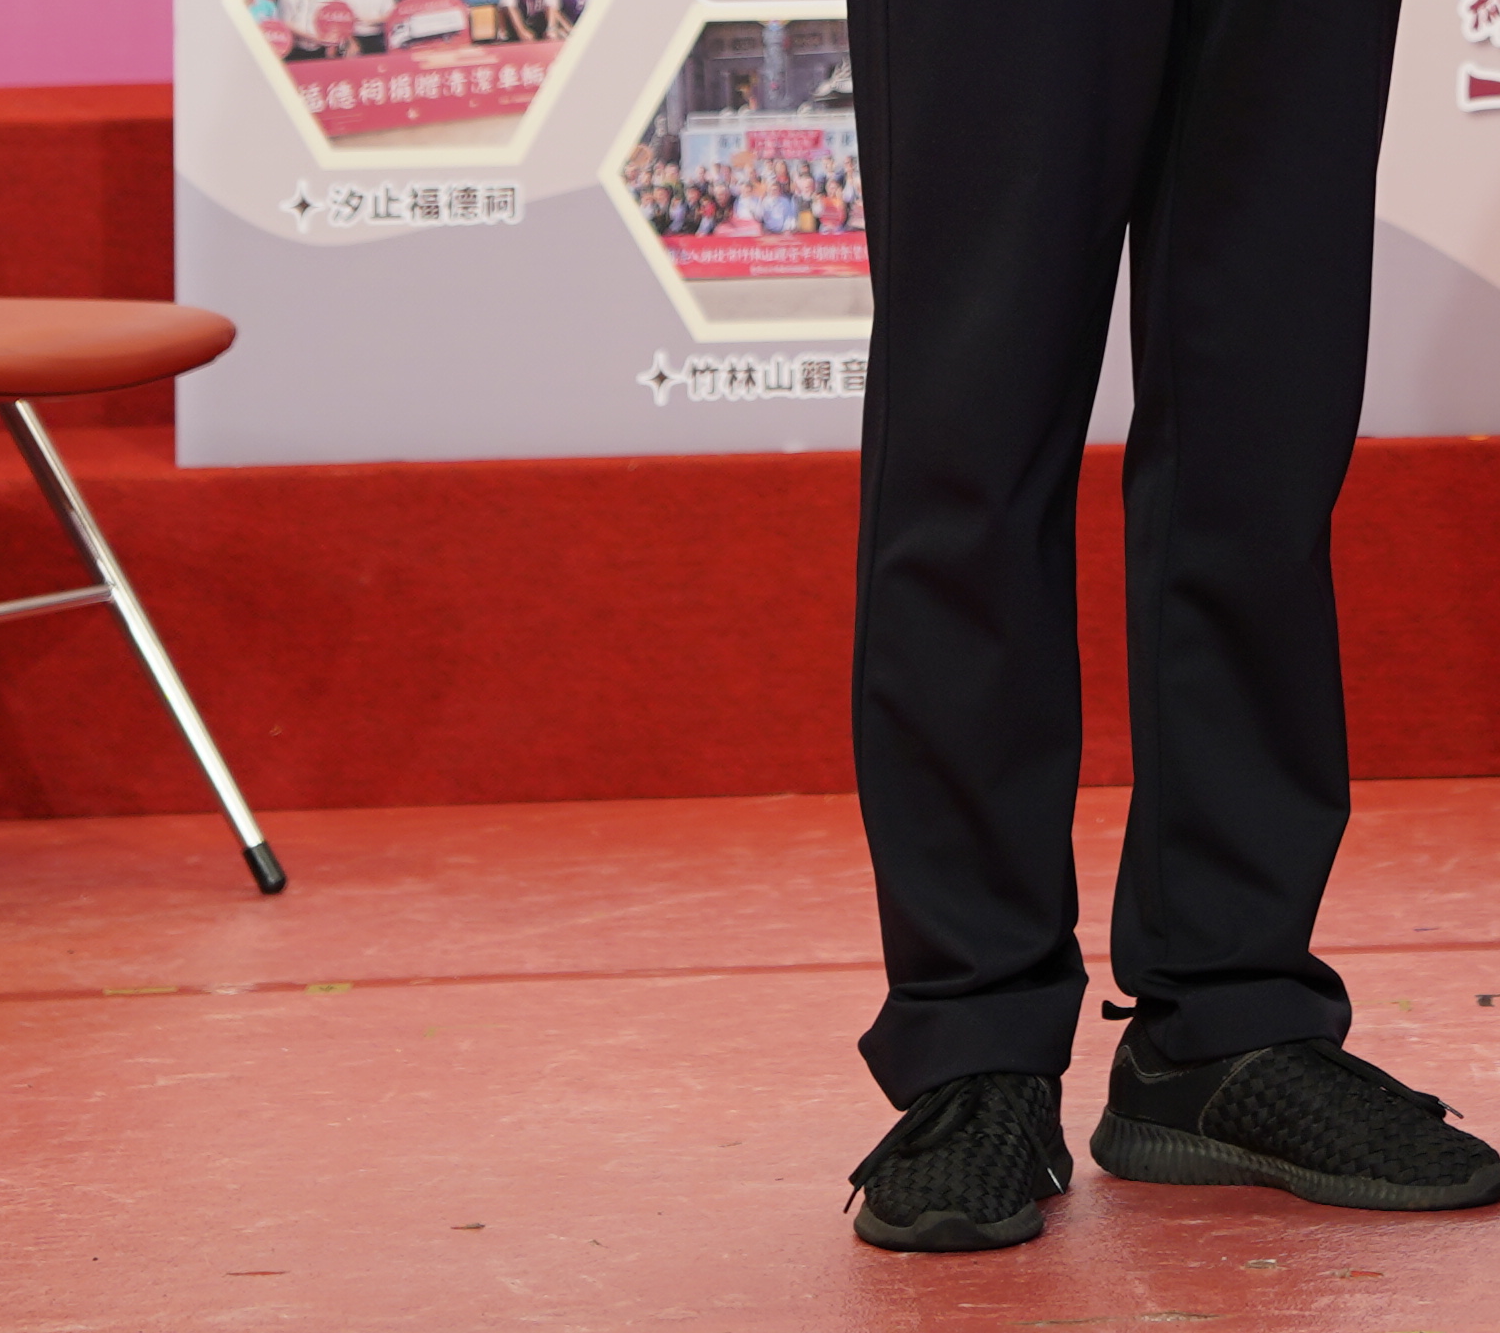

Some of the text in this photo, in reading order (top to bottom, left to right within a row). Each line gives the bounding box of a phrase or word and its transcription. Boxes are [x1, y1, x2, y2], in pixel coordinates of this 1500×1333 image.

[333, 188, 518, 222] 汐止福德祠
